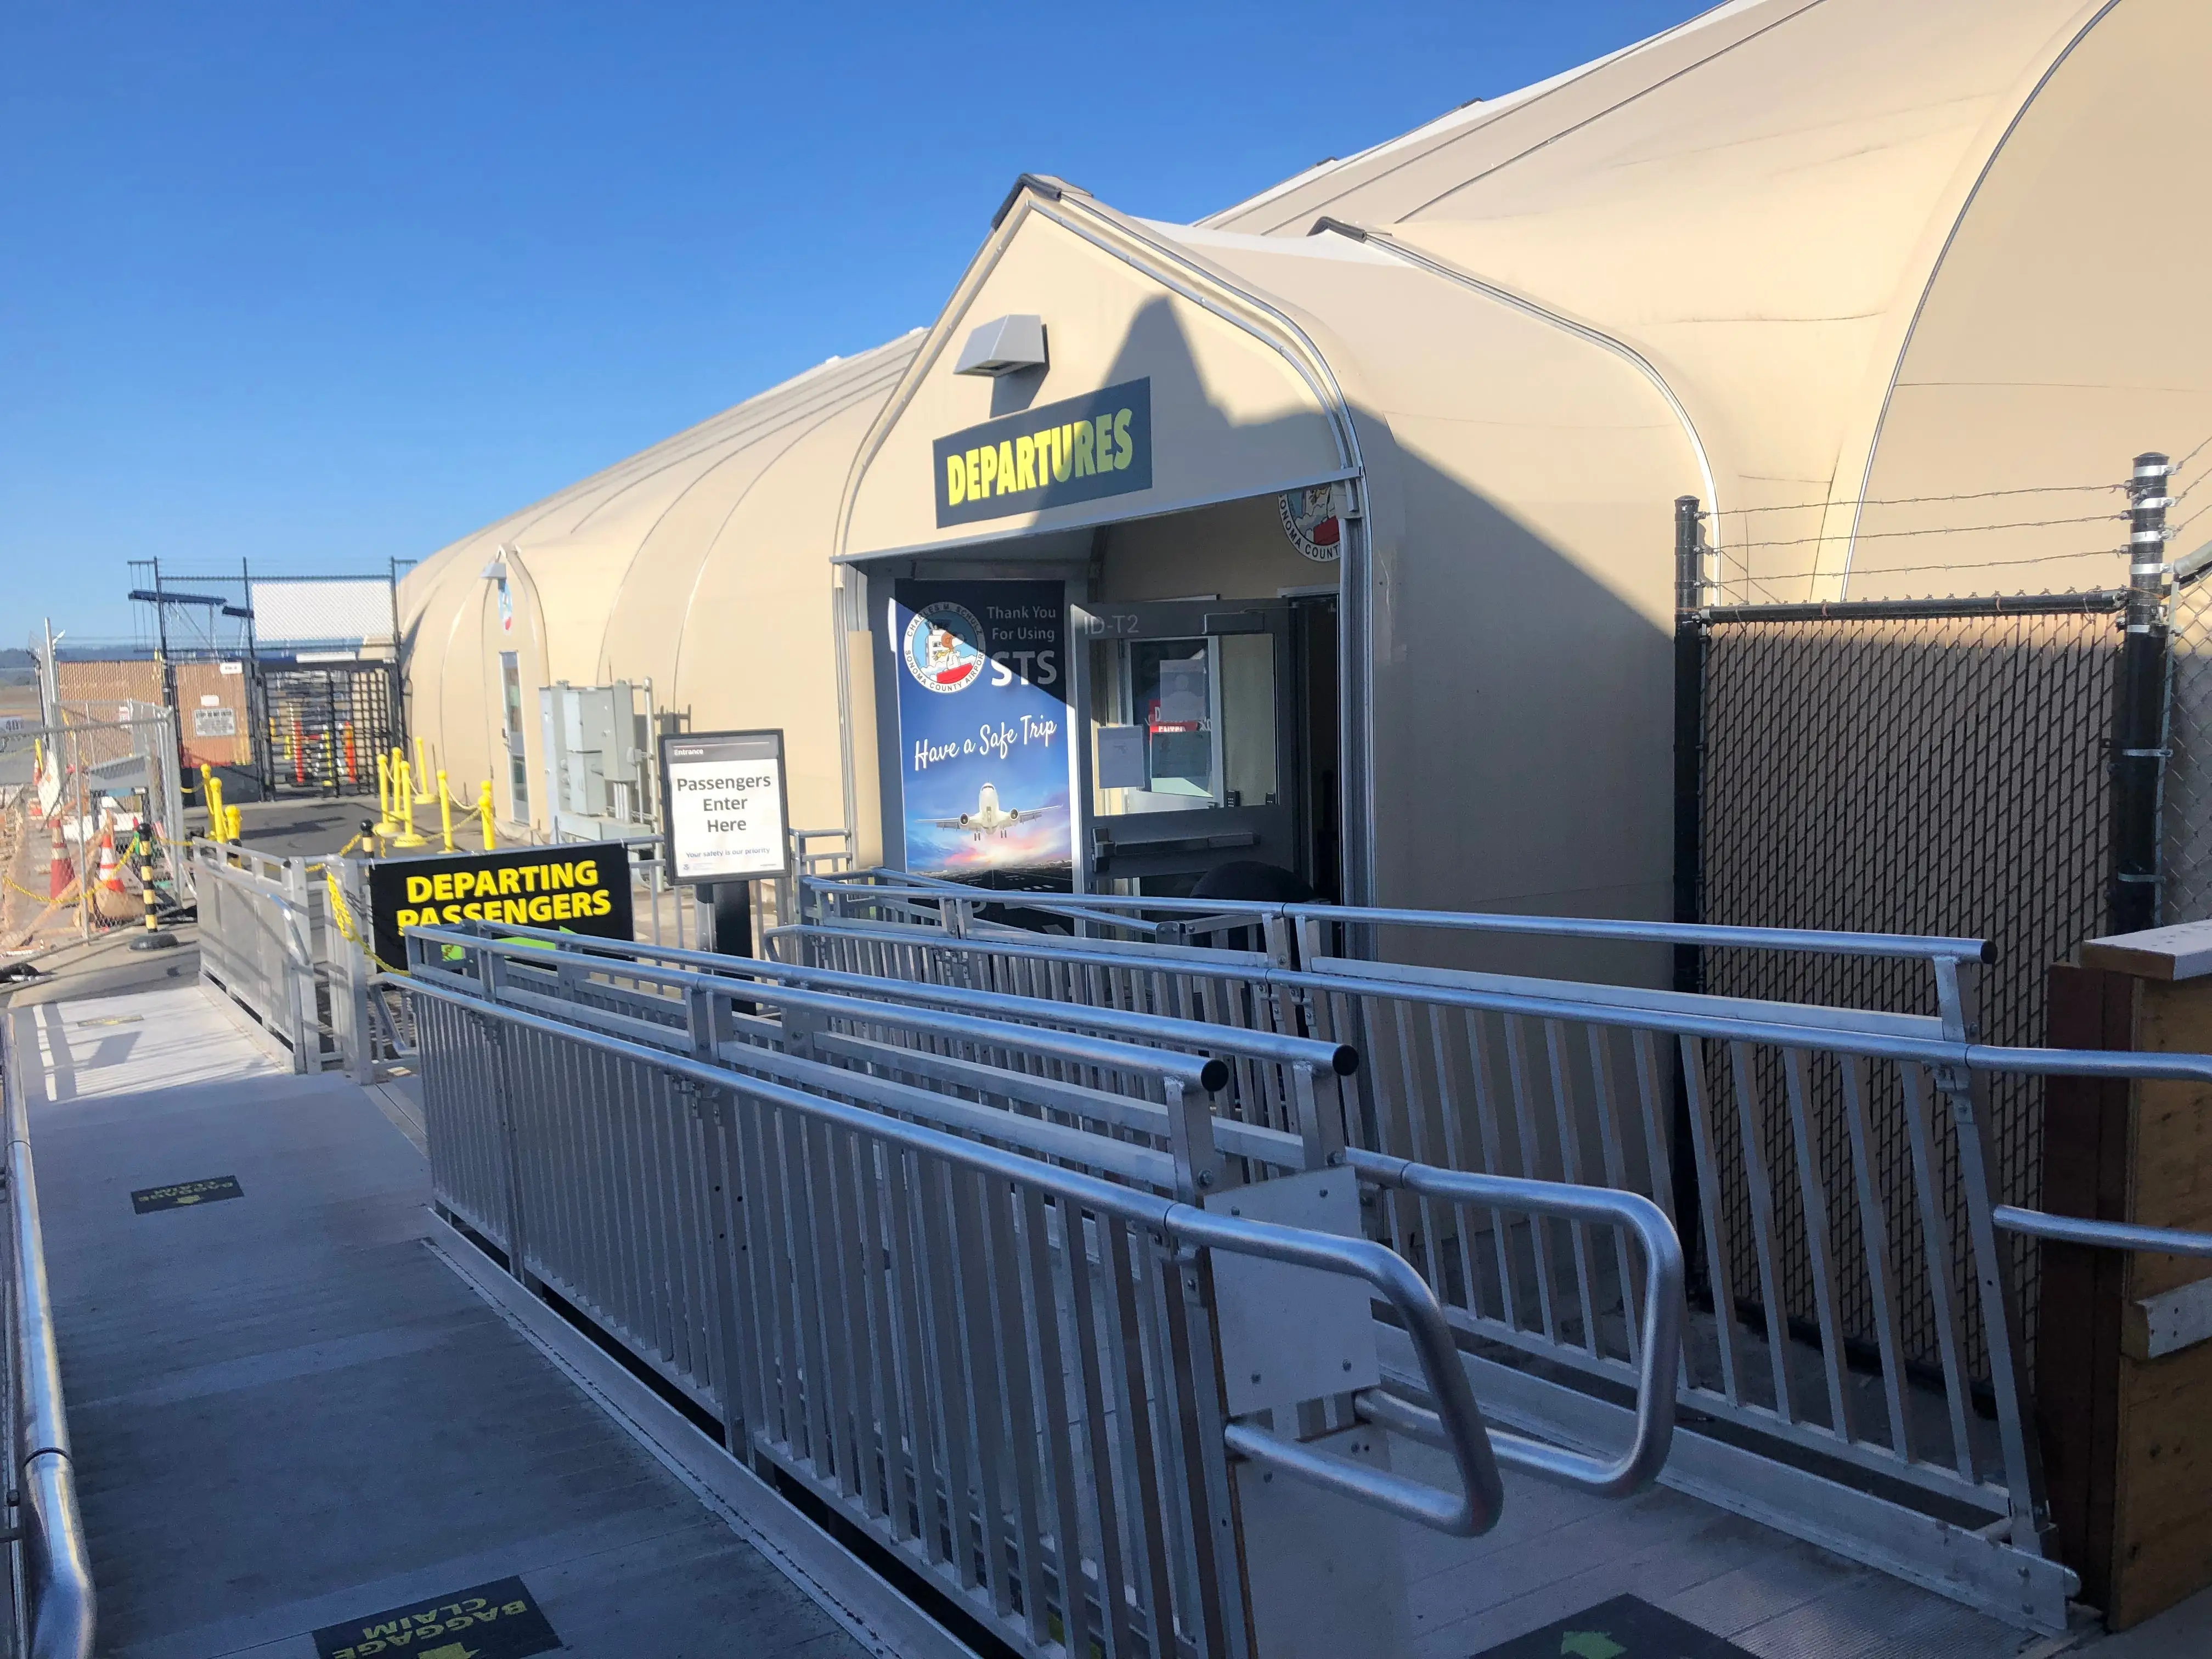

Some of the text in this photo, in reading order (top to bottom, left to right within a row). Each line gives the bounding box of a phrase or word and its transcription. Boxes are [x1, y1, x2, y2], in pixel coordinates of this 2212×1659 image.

[947, 408, 1133, 506] DEPARTURES
[1279, 494, 1339, 559] ONOMA COUNT
[907, 605, 939, 637] CHARLES
[956, 606, 983, 636] SCHULZ
[986, 605, 1056, 619] Thank You
[1084, 614, 1139, 635] ID-T2
[992, 626, 1055, 642] For Using
[905, 648, 985, 692] SONOMA COUNTY AIRPORT
[991, 650, 1057, 686] STS
[915, 714, 1058, 771] Have a Safe Trip
[676, 775, 771, 791] Passengers
[703, 797, 748, 811] Enter
[707, 820, 747, 832] Here
[406, 860, 598, 904] DEPARTING
[396, 889, 611, 937] PASSENGERS
[332, 1600, 527, 1659] BAGGAGE
[362, 1598, 487, 1640] CLAIM
